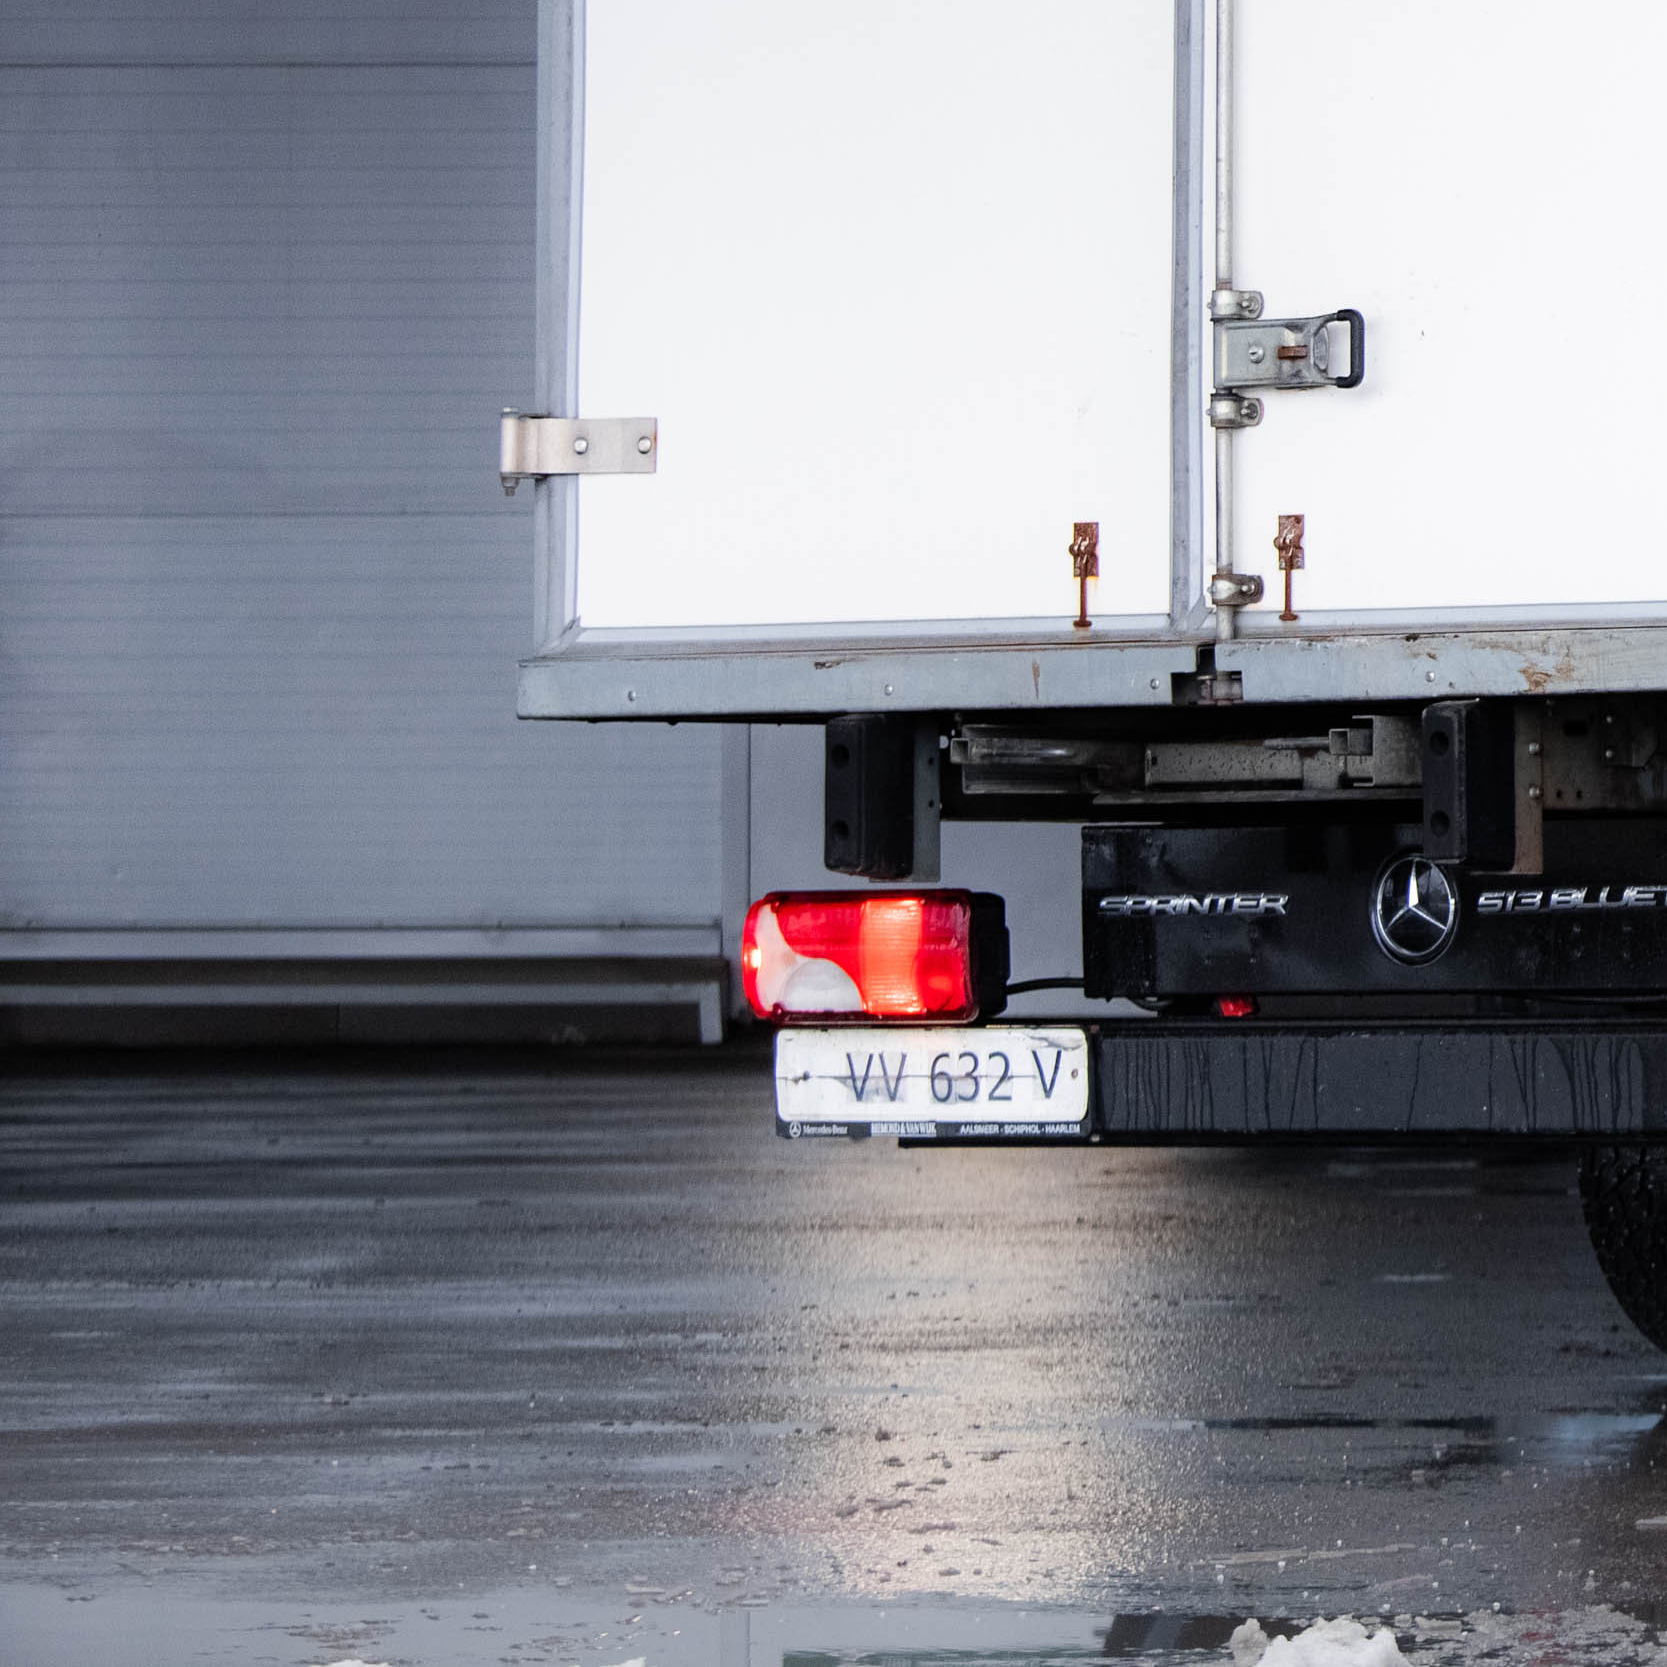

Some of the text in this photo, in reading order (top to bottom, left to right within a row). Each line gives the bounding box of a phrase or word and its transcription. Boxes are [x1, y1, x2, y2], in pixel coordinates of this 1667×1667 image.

[1098, 892, 1289, 917] SPRINTER
[1477, 889, 1544, 914] 513
[846, 1048, 1062, 1103] VV 632 V
[1045, 1123, 1081, 1135] HAARLEM
